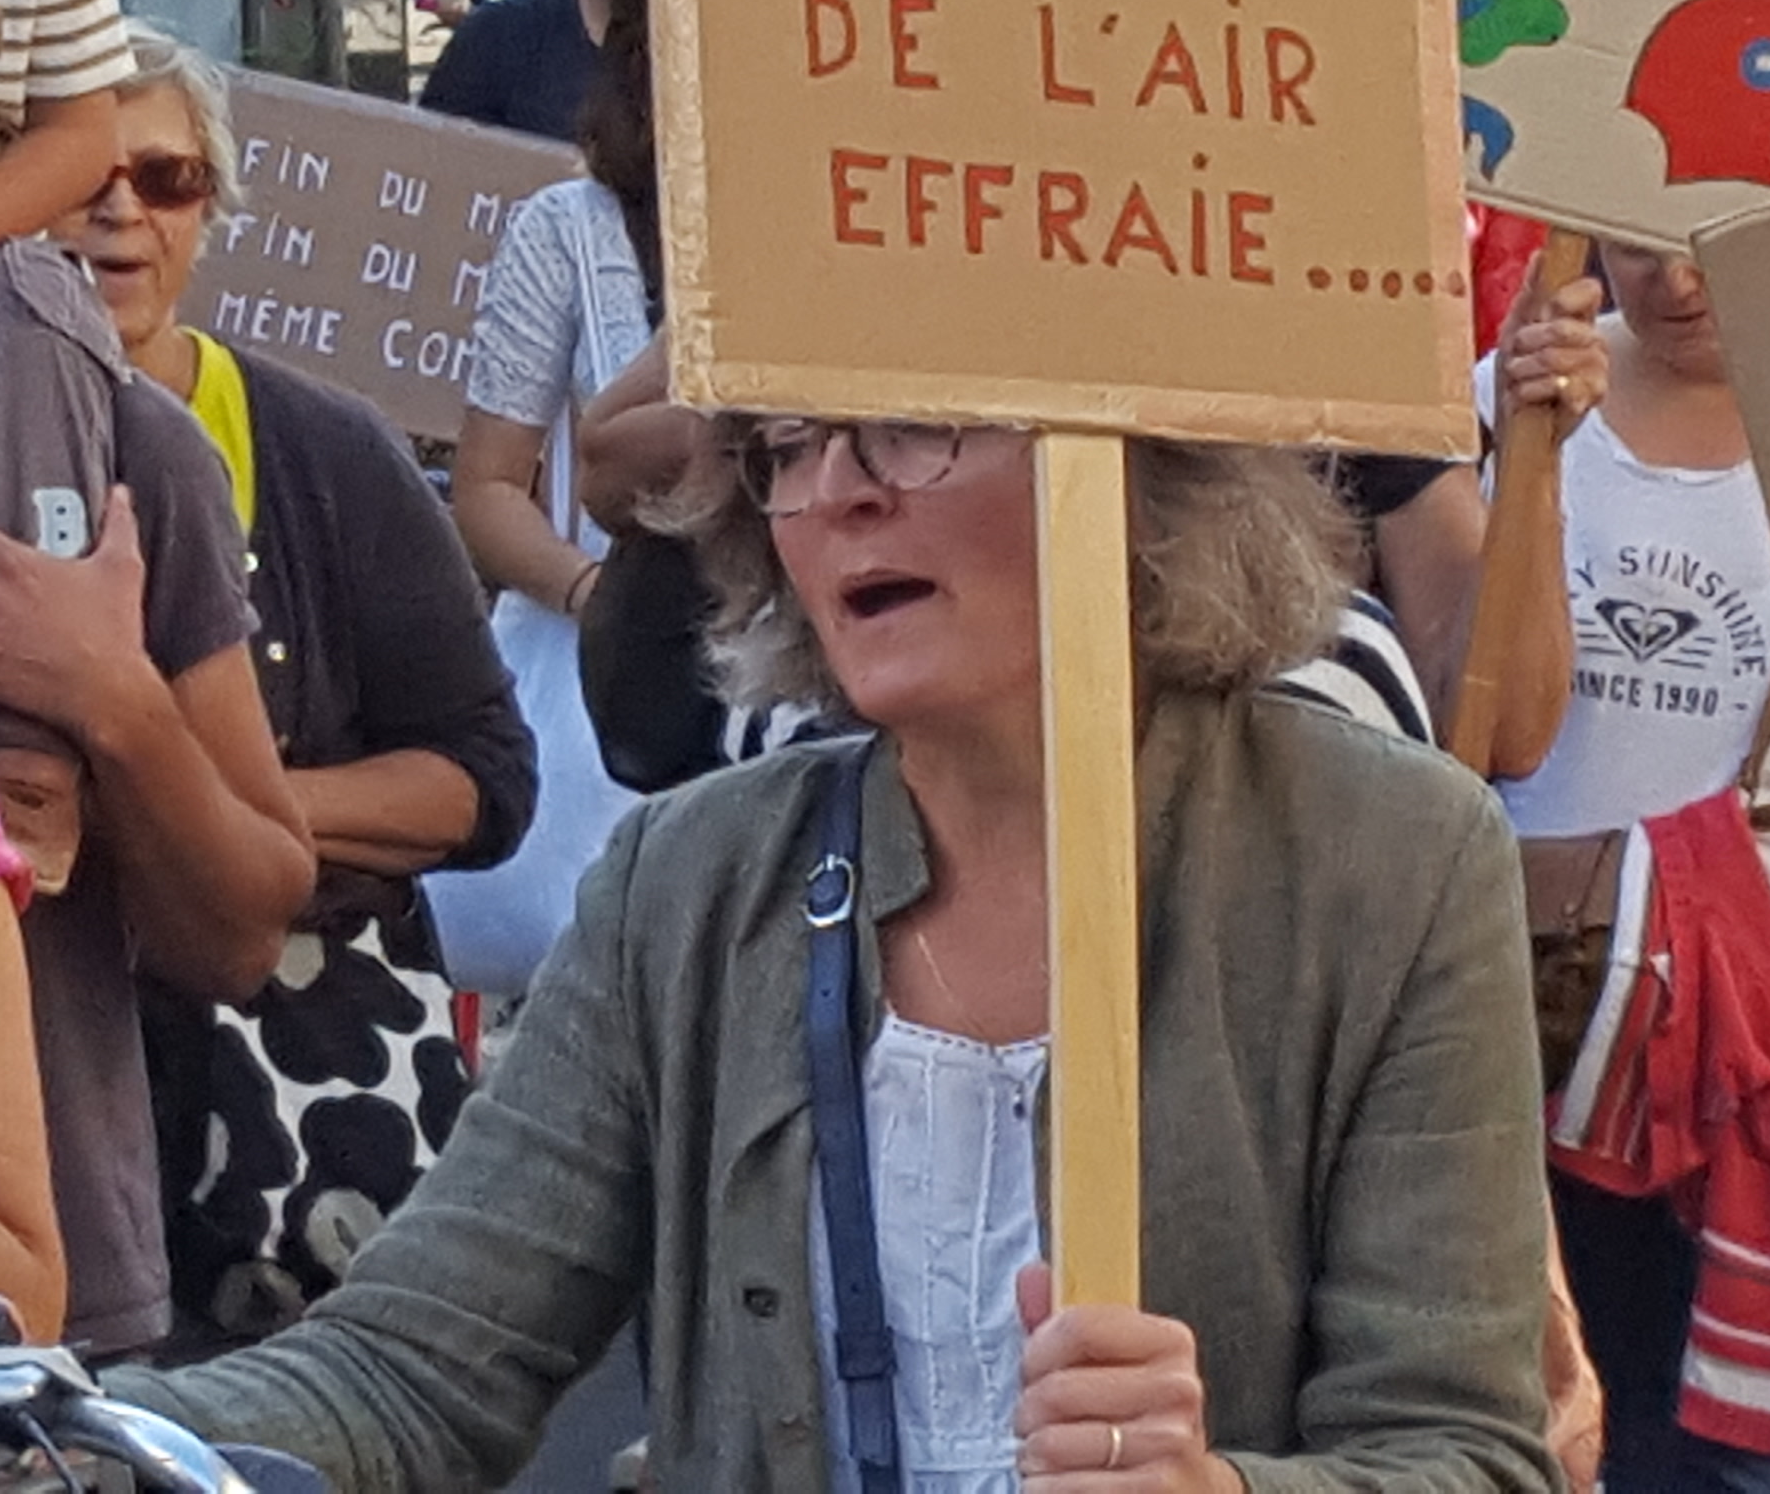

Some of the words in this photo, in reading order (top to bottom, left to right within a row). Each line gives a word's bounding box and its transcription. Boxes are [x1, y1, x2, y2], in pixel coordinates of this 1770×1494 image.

[379, 170, 428, 216] DU
[362, 243, 417, 293] DU
[1570, 668, 1643, 708] INCE
[1654, 682, 1721, 718] 1990
